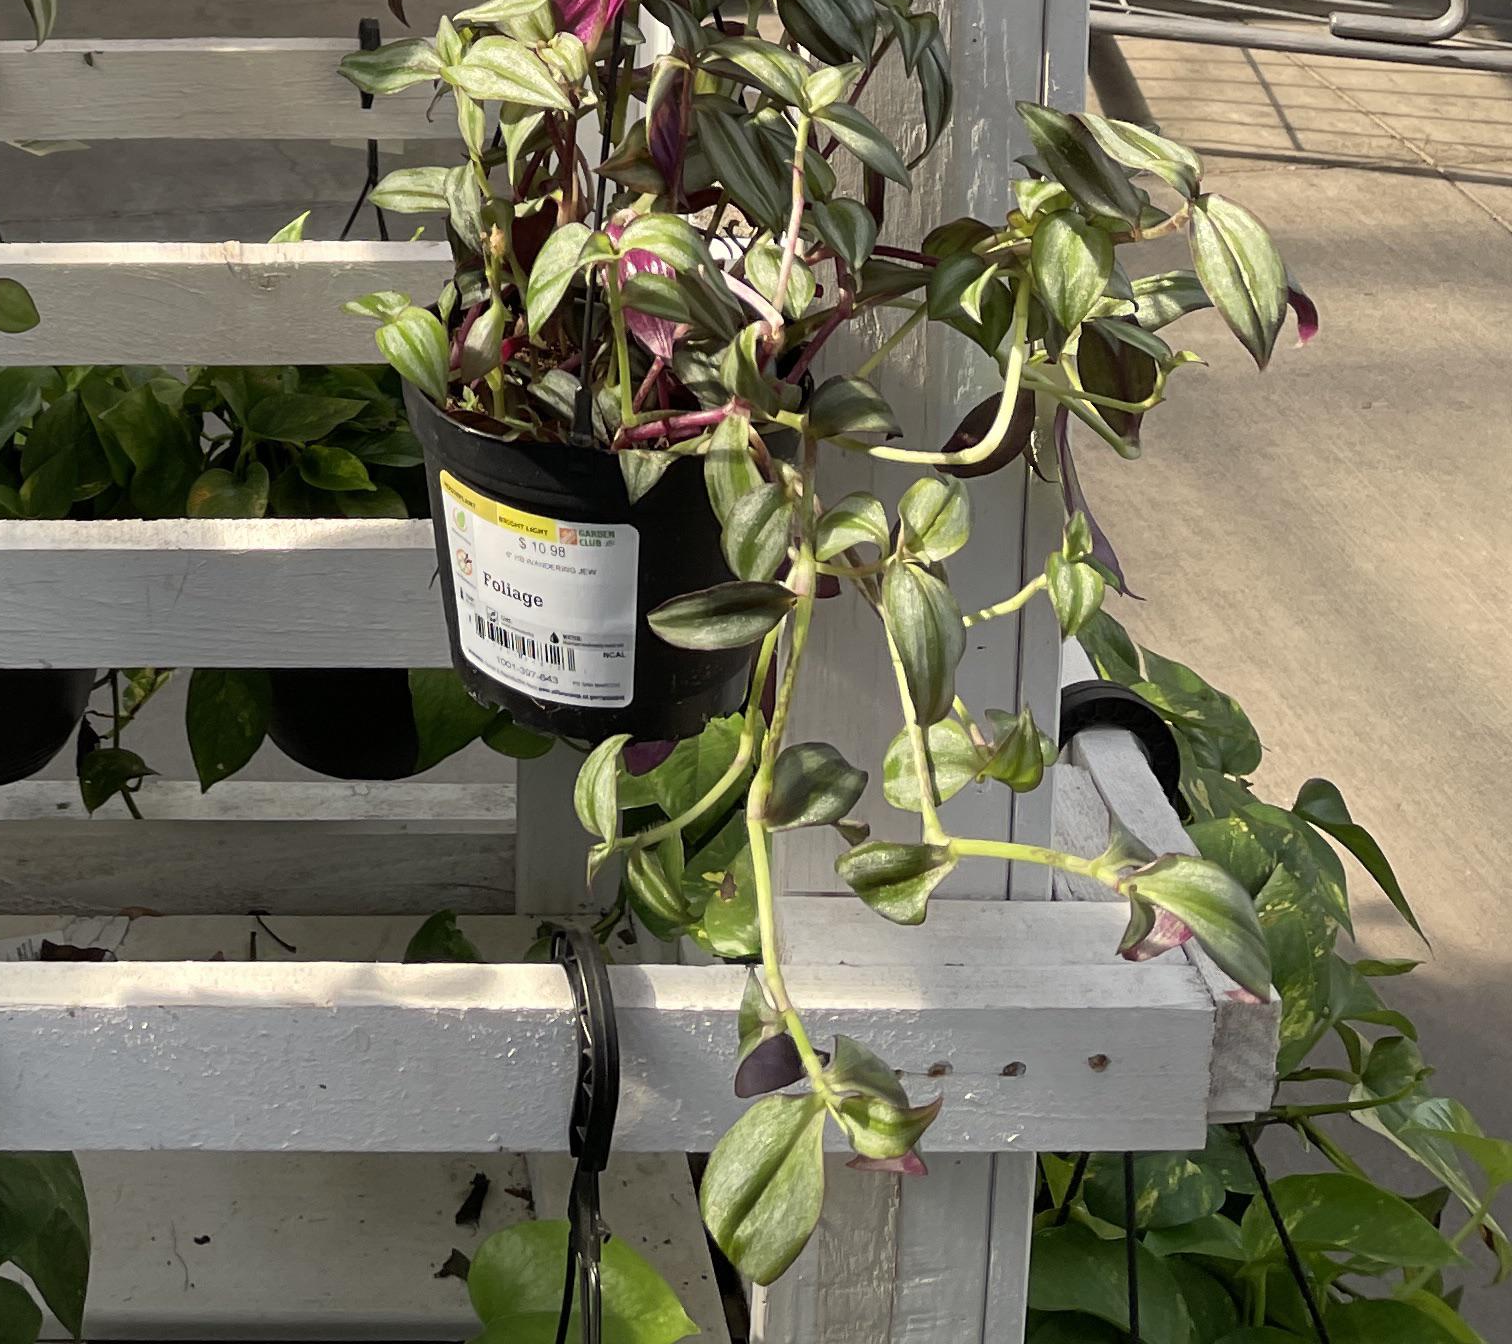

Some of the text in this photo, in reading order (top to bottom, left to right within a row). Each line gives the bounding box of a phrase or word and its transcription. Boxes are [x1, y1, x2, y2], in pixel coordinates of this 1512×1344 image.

[498, 515, 548, 537] BRIGHT LIGHT
[579, 529, 615, 539] GARDEN
[580, 538, 602, 547] CLUB
[578, 568, 598, 576] JEW
[482, 571, 544, 608] Foliage
[603, 651, 626, 659] NCAL
